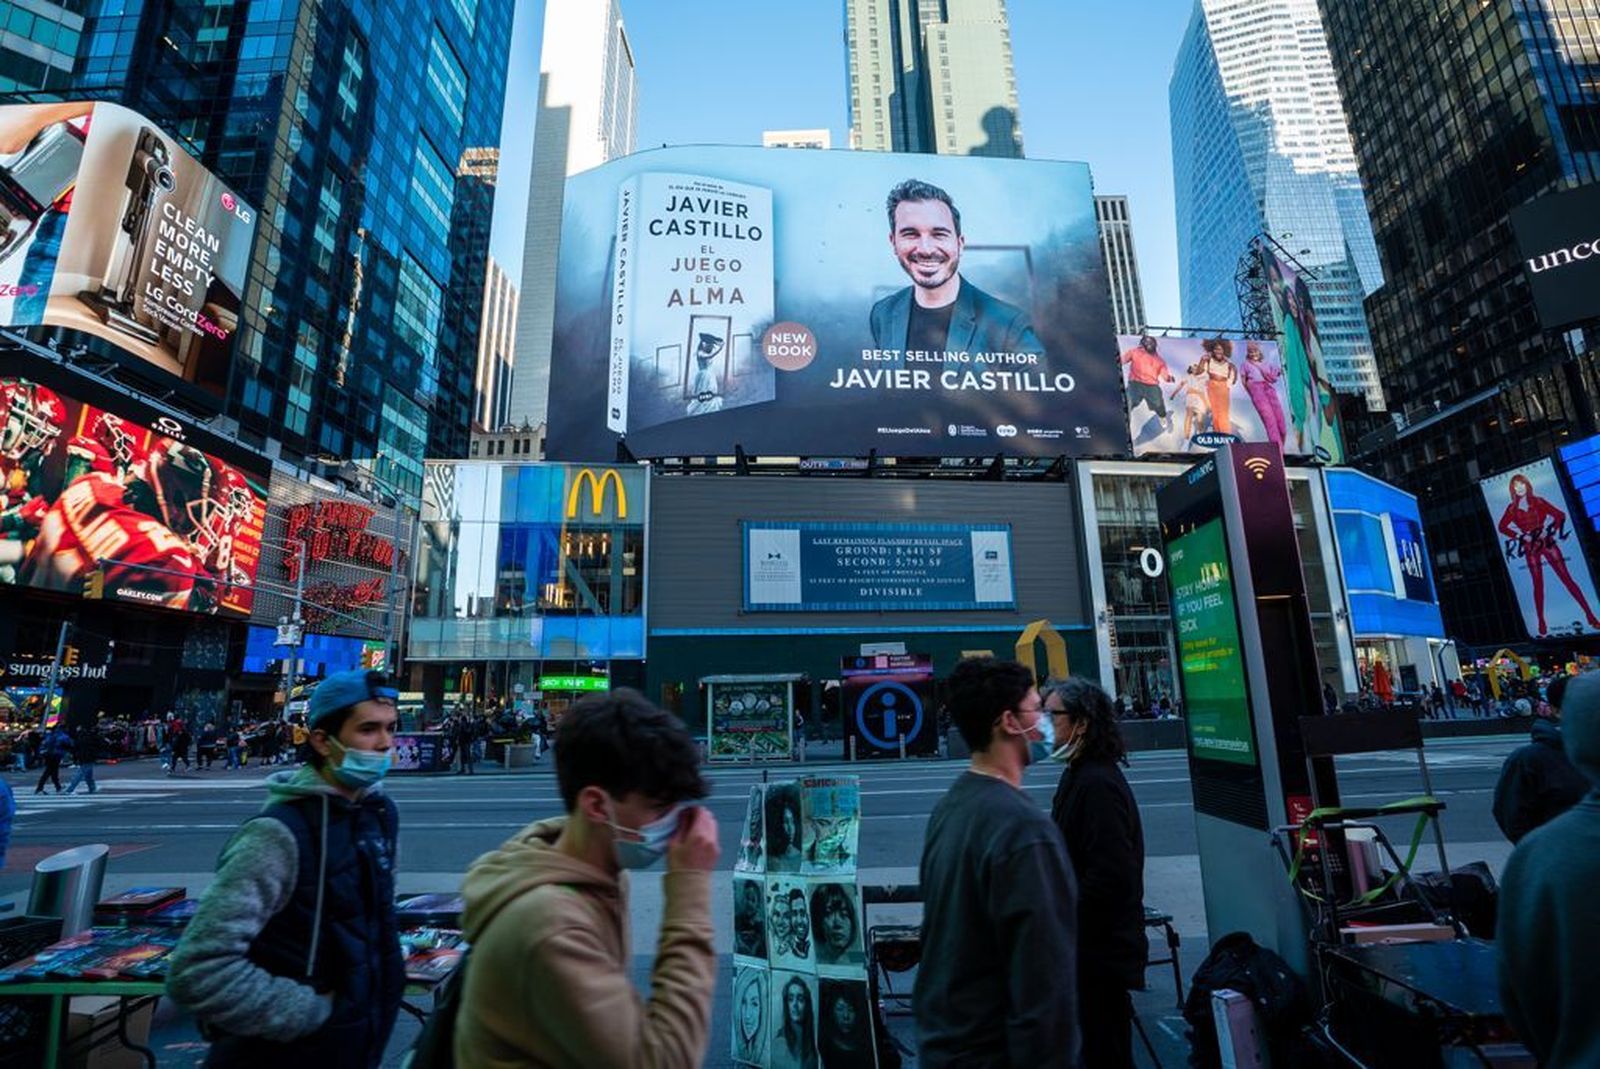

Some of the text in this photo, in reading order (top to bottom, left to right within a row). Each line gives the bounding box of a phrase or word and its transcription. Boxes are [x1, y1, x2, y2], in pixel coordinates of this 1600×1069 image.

[235, 205, 251, 224] LG
[622, 190, 630, 242] JAVIER
[666, 195, 748, 219] JAVIER
[163, 202, 220, 253] CLEAN
[648, 219, 763, 241] CASTILLO
[160, 219, 214, 272] MORE,
[701, 245, 715, 254] EL
[155, 238, 215, 288] EMPTY
[671, 258, 742, 272] JUEGO
[150, 258, 194, 296] LESS
[616, 248, 627, 325] CASTILLO
[695, 275, 719, 284] DEL
[145, 282, 164, 301] LG
[667, 287, 745, 308] ALMA
[771, 333, 807, 343] NEW
[768, 345, 812, 356] BOOK
[862, 350, 1038, 364] BEST SELLING AUTHOR
[830, 369, 1075, 392] JAVIER CASTILLO
[151, 422, 187, 441] OAKLEY
[1197, 436, 1235, 444] OLD NAVY
[1505, 517, 1572, 564] REBEL
[835, 546, 892, 555] GROUND:
[929, 546, 942, 555] SF
[836, 557, 892, 566] SECOND:
[929, 557, 941, 566] SF
[860, 587, 922, 596] DIVISIBLE
[1175, 583, 1195, 600] STAY
[1178, 594, 1224, 616] IF YOU FEEL
[1180, 618, 1199, 633] SICK
[9, 662, 107, 679] sungass hut
